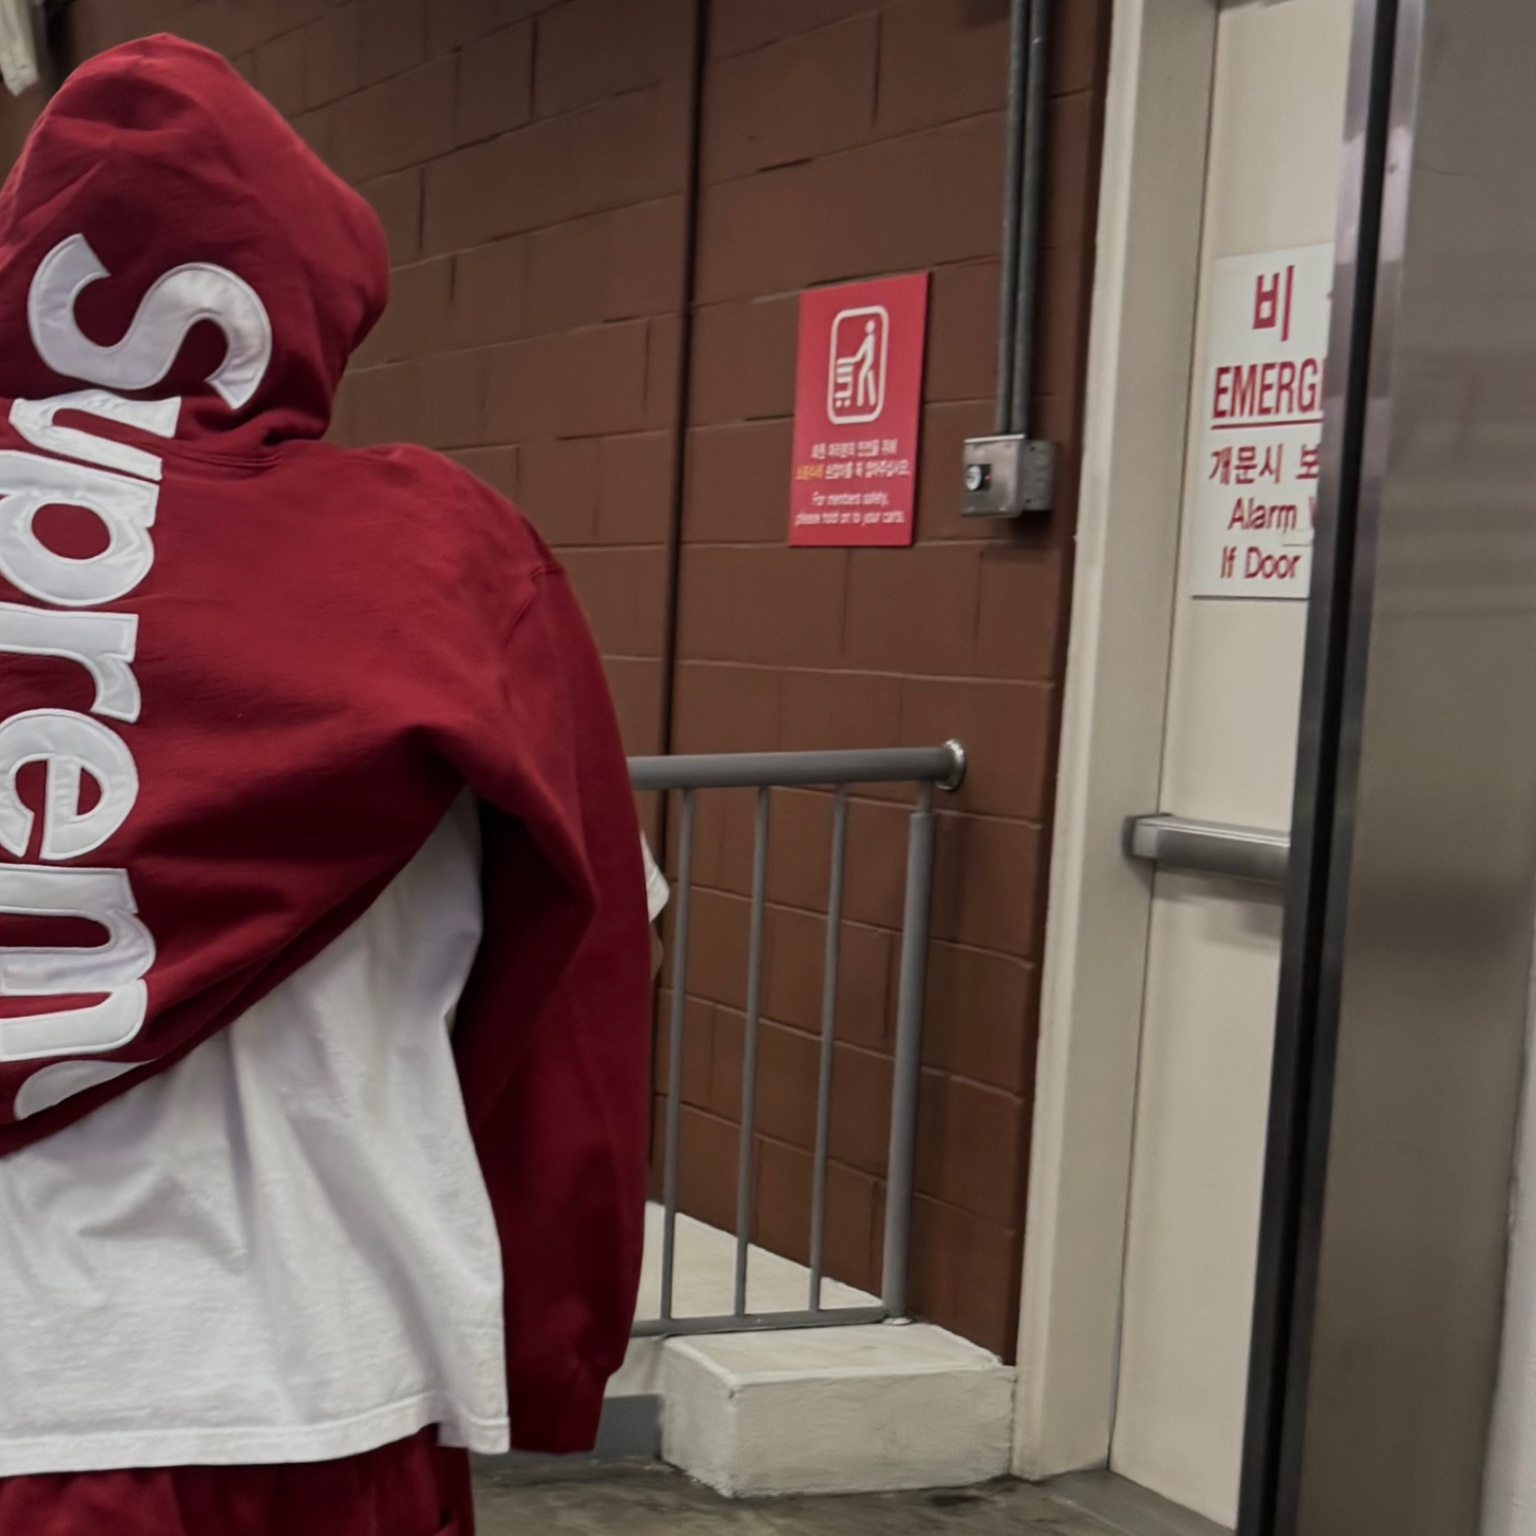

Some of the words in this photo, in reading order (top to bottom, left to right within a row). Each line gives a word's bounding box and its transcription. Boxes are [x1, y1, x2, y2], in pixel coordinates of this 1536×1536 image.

[1252, 265, 1295, 342] 비
[1212, 358, 1323, 419] EMERG
[1208, 443, 1283, 486] 개문시
[1227, 497, 1297, 531] Alarm
[1220, 546, 1237, 579] If
[1244, 546, 1301, 579] Door
